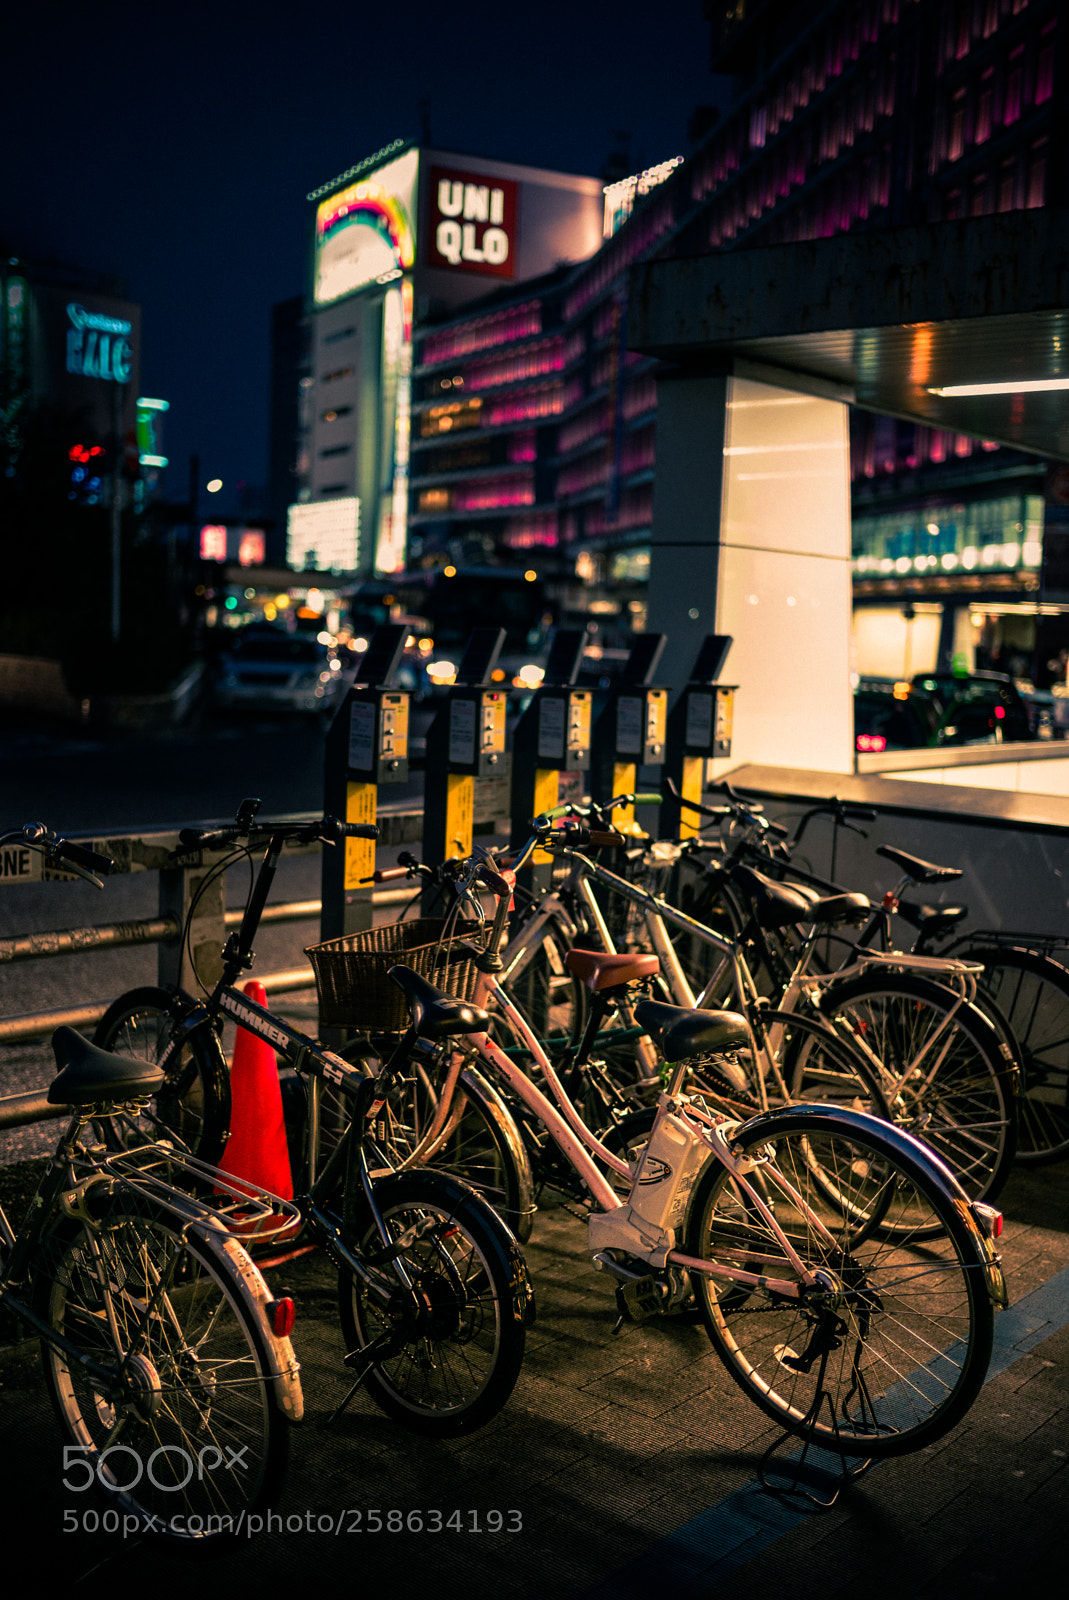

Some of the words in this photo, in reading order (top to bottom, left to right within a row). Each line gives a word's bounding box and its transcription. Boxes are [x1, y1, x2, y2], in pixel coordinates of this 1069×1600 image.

[438, 179, 504, 225] UNI
[436, 219, 509, 265] QLO
[219, 992, 290, 1050] HUMMER
